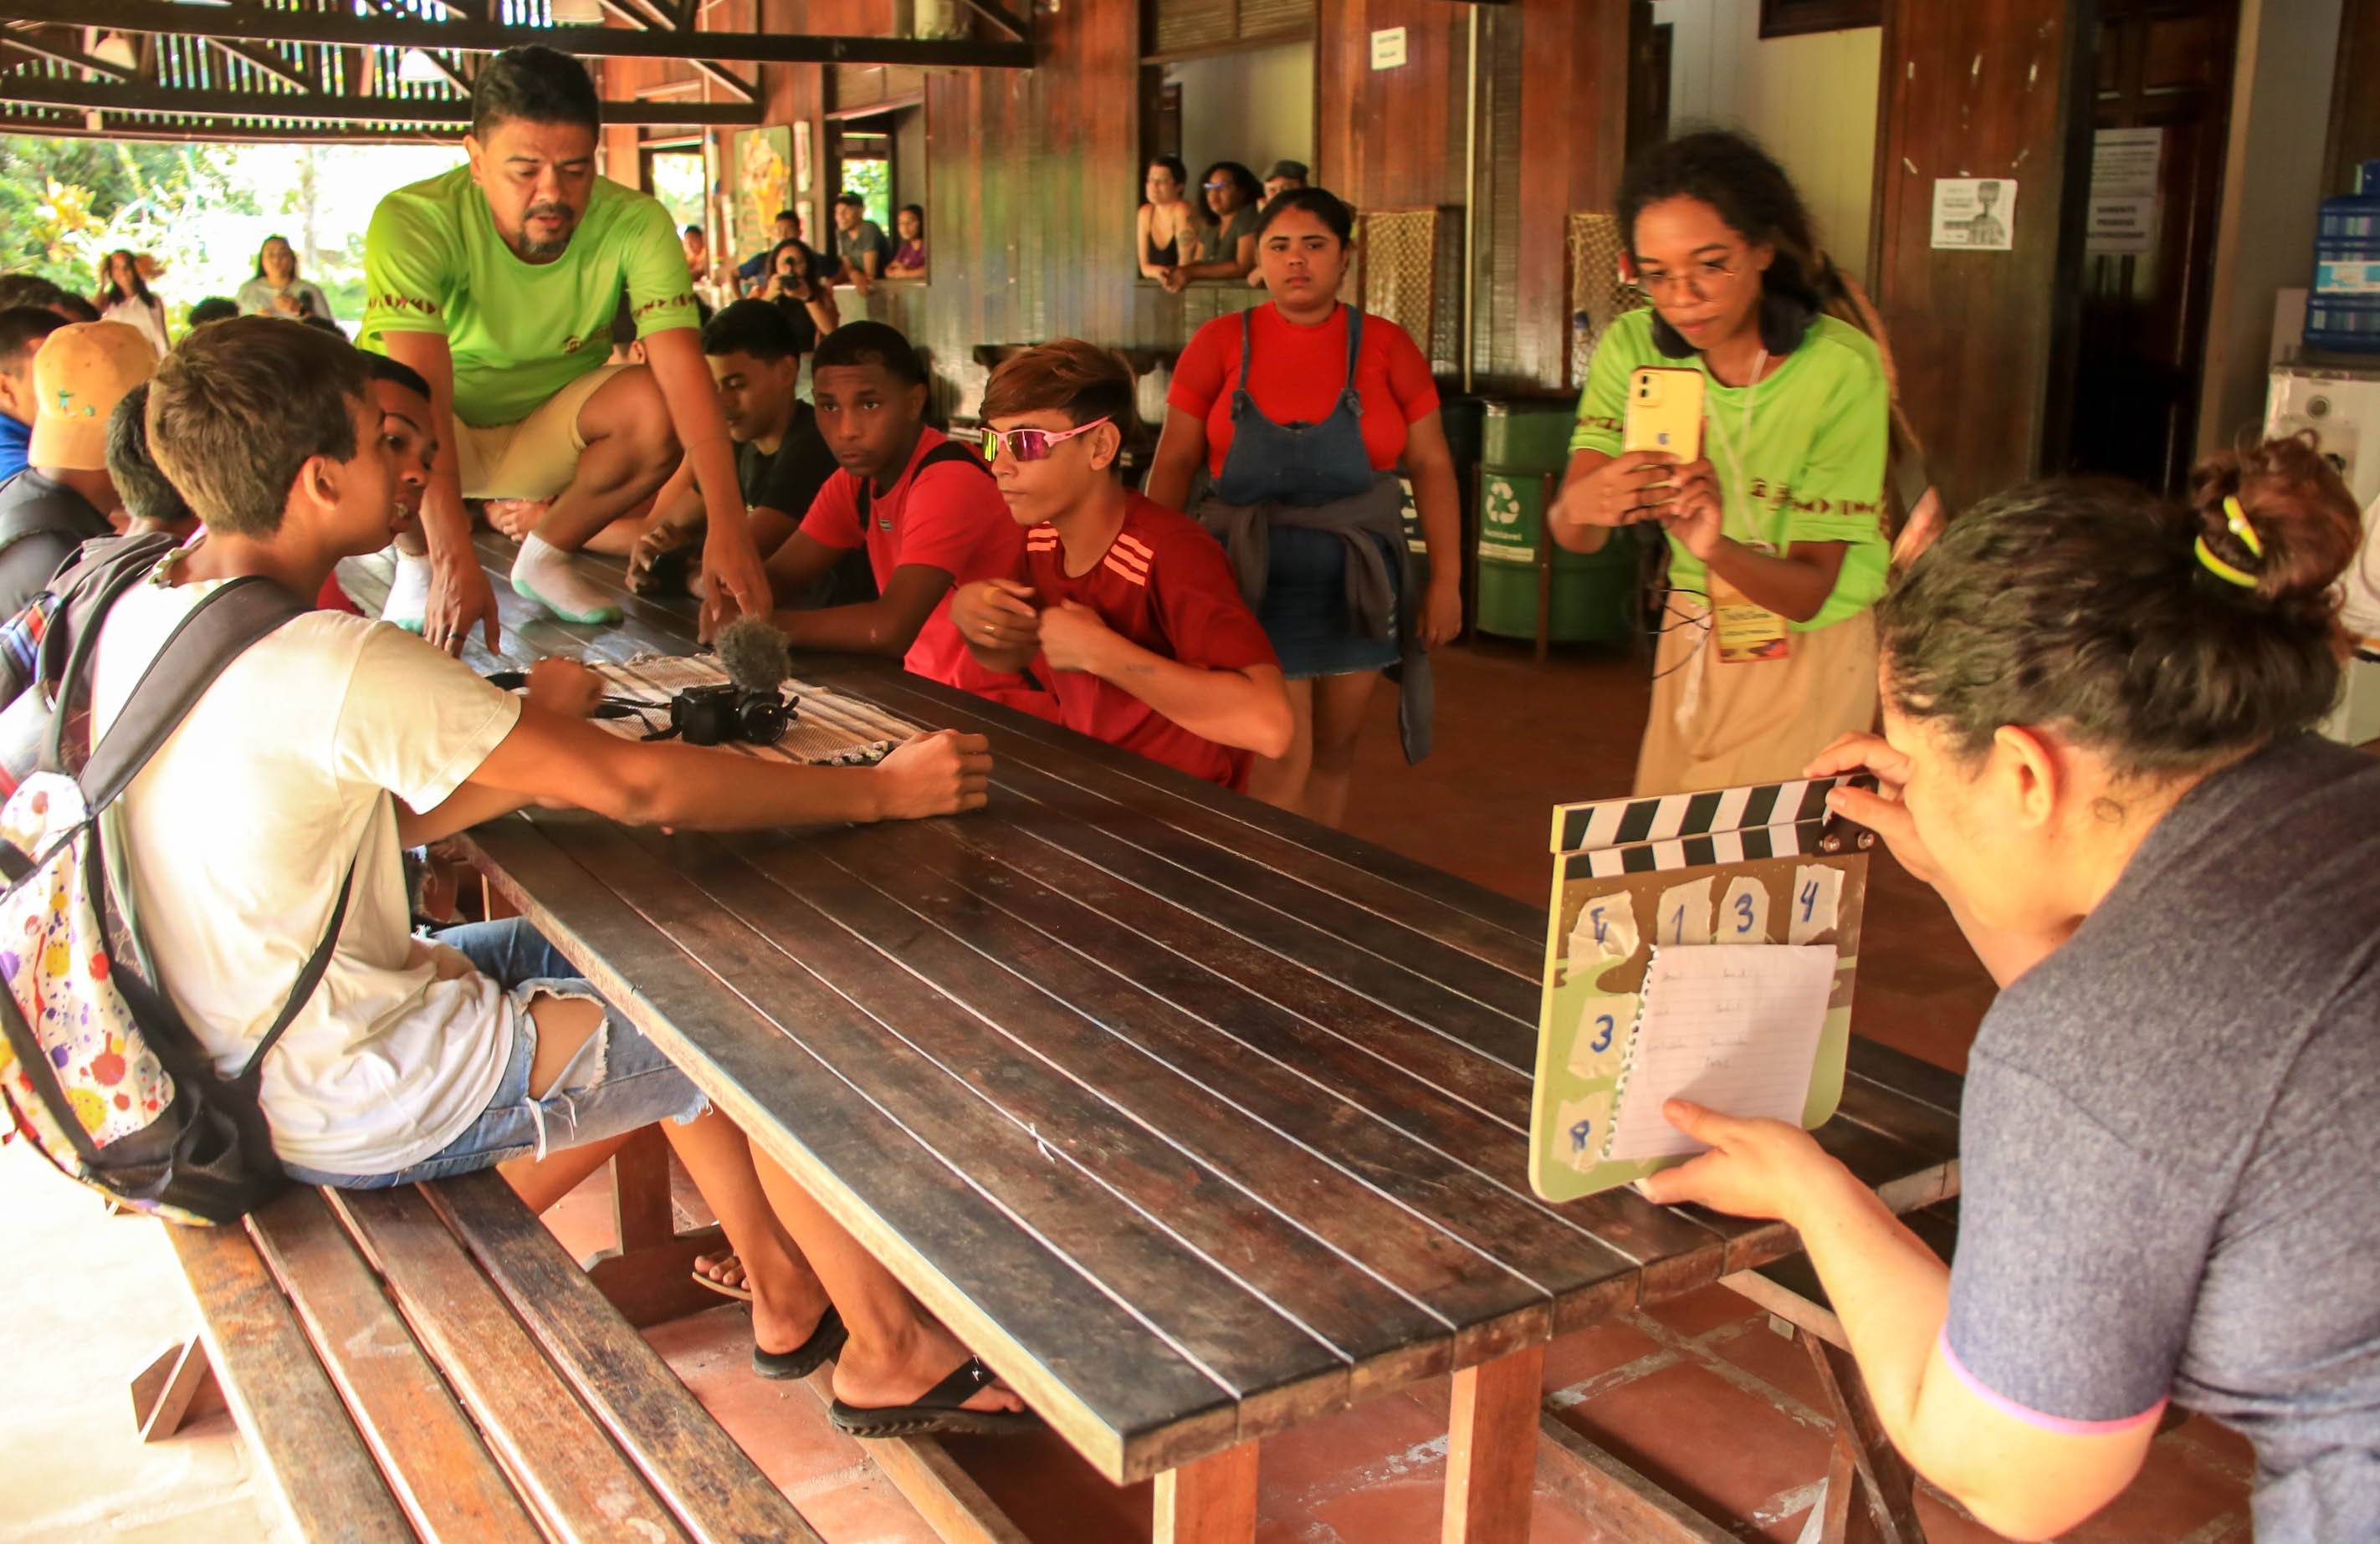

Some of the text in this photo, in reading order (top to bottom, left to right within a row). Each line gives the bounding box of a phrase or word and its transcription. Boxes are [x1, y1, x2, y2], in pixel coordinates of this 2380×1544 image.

[1671, 903, 1685, 945] 1
[1734, 892, 1754, 933] 3
[1799, 879, 1819, 924] 4
[1590, 1013, 1615, 1054] 3
